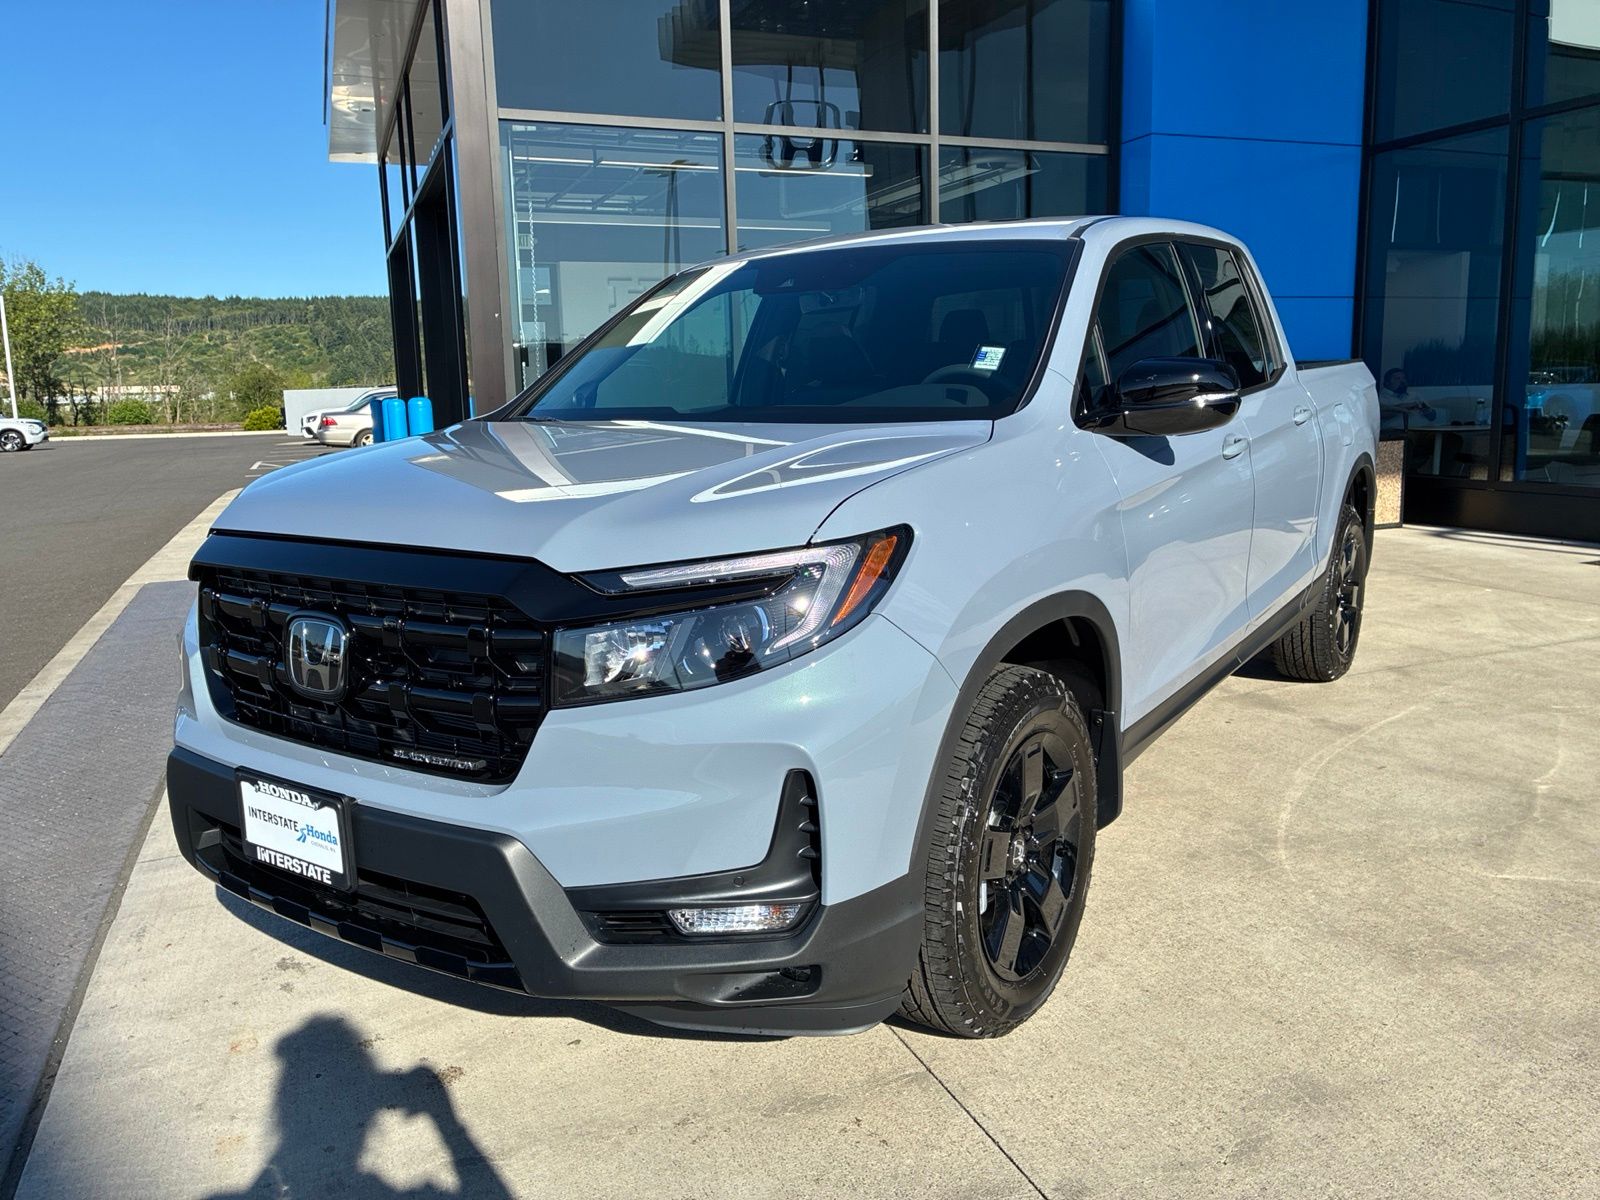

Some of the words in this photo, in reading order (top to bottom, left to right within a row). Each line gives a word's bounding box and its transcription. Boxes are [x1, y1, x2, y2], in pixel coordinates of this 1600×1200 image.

[257, 781, 313, 807] HONDA
[248, 806, 299, 832] INTERSTATE
[306, 824, 338, 845] Honda
[257, 846, 332, 885] INTERSTATE
